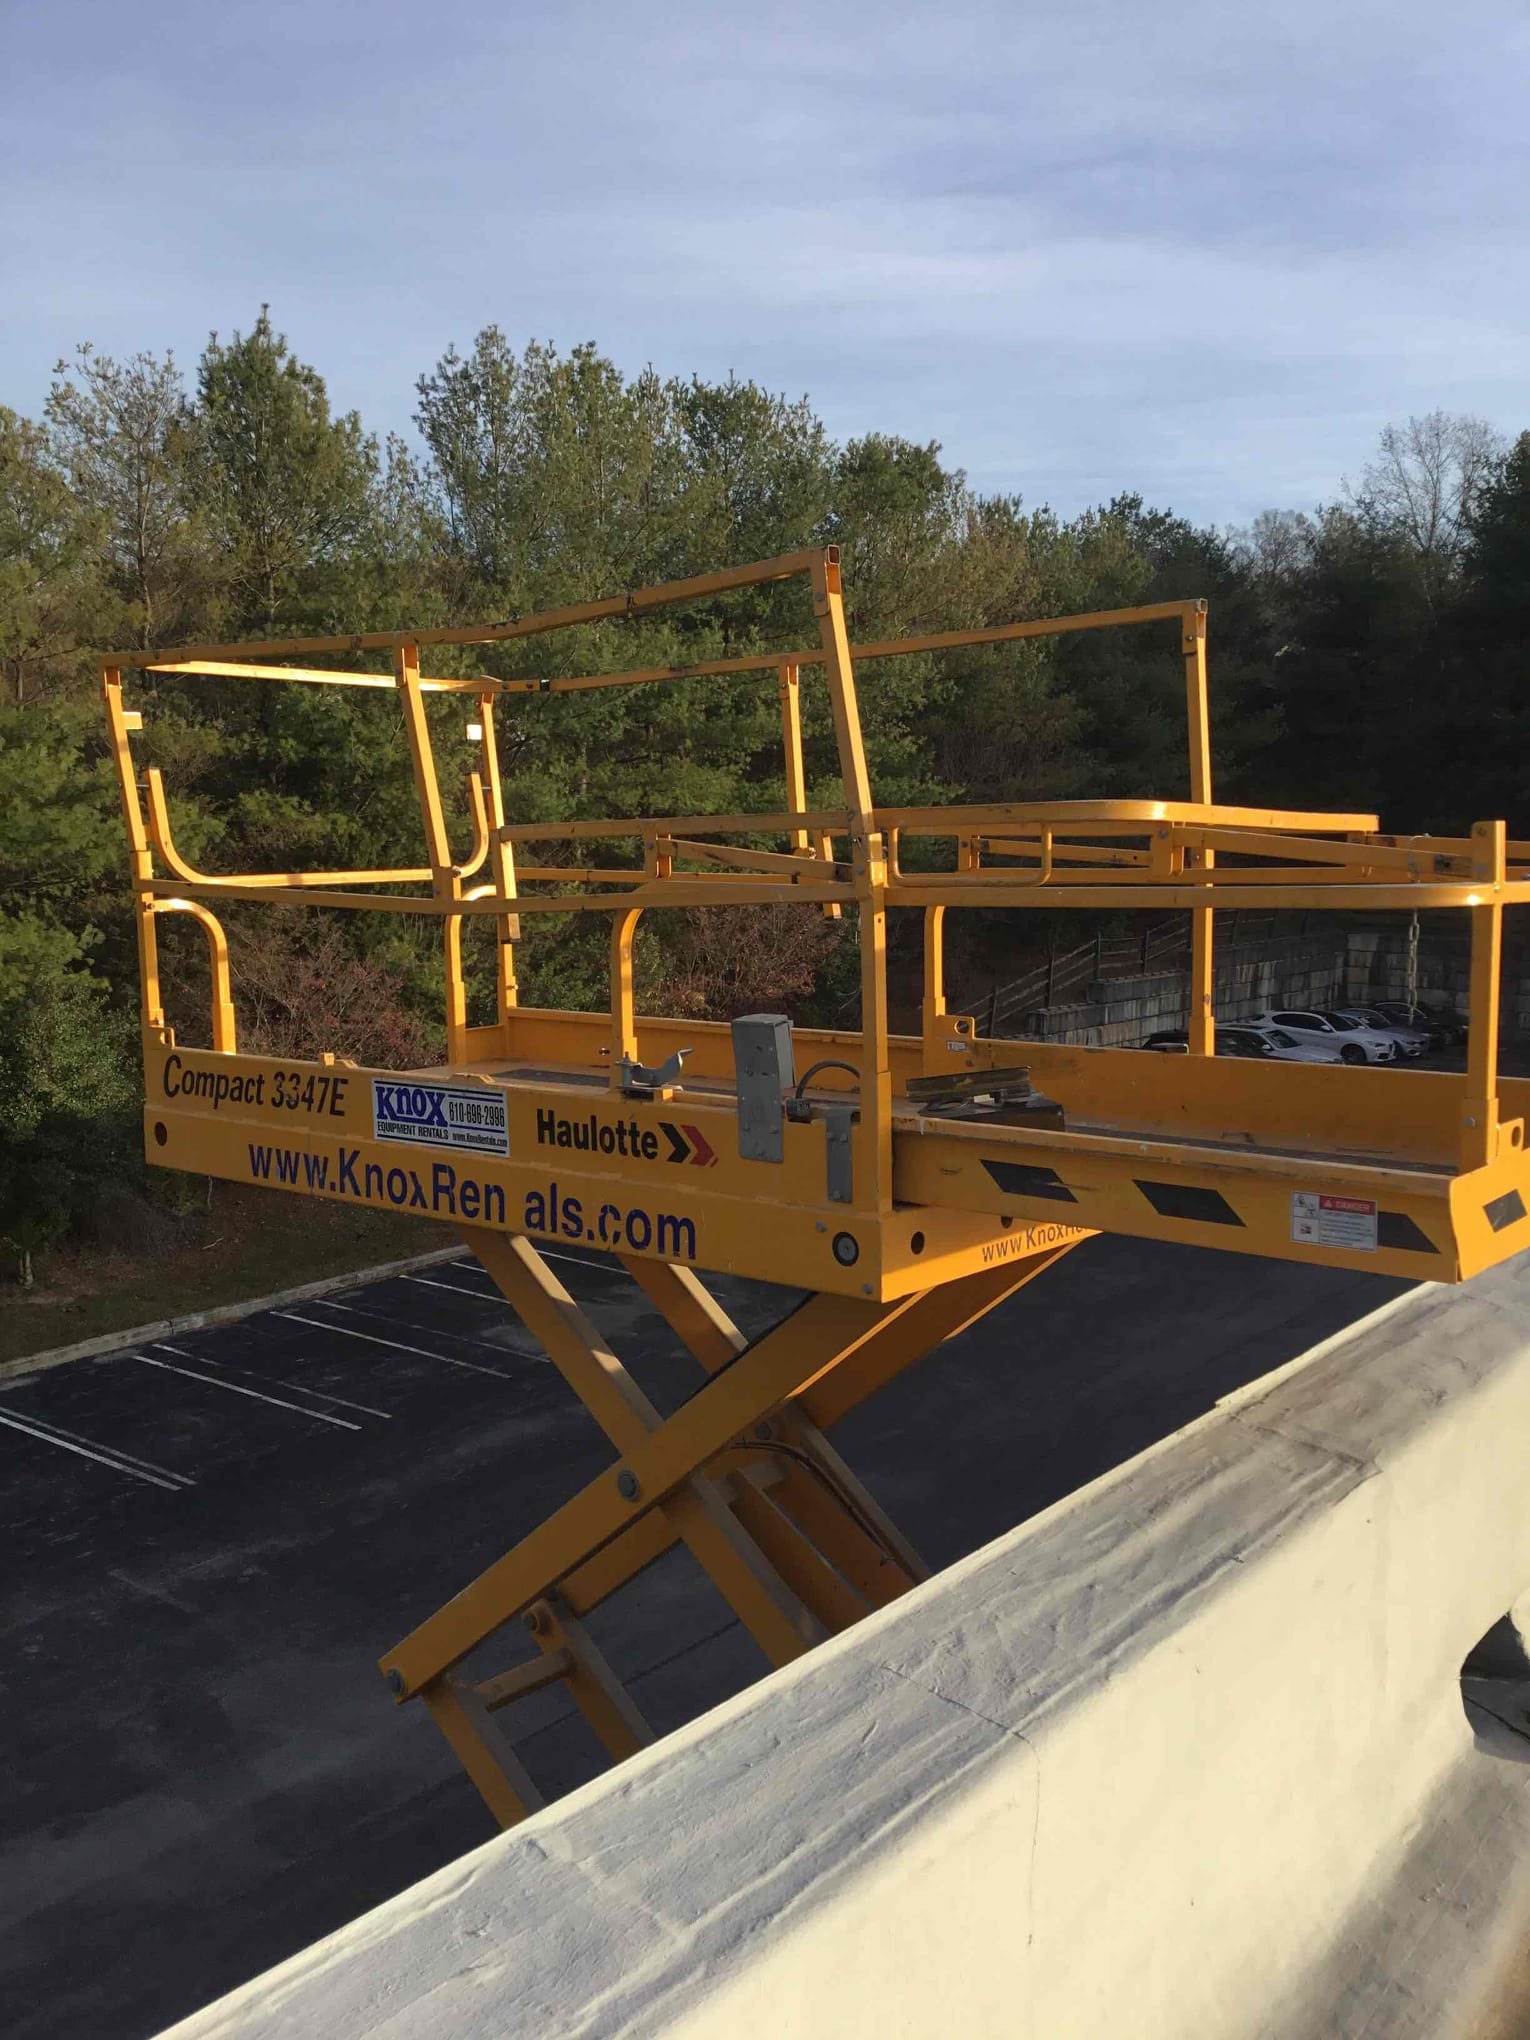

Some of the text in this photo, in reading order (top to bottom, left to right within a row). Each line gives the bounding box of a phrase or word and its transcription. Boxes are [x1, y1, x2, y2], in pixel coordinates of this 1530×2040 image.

[163, 1055, 349, 1117] Compact 3347E
[377, 1121, 449, 1140] EQUIPMENT RENTALS
[537, 1109, 658, 1160] Haulotte
